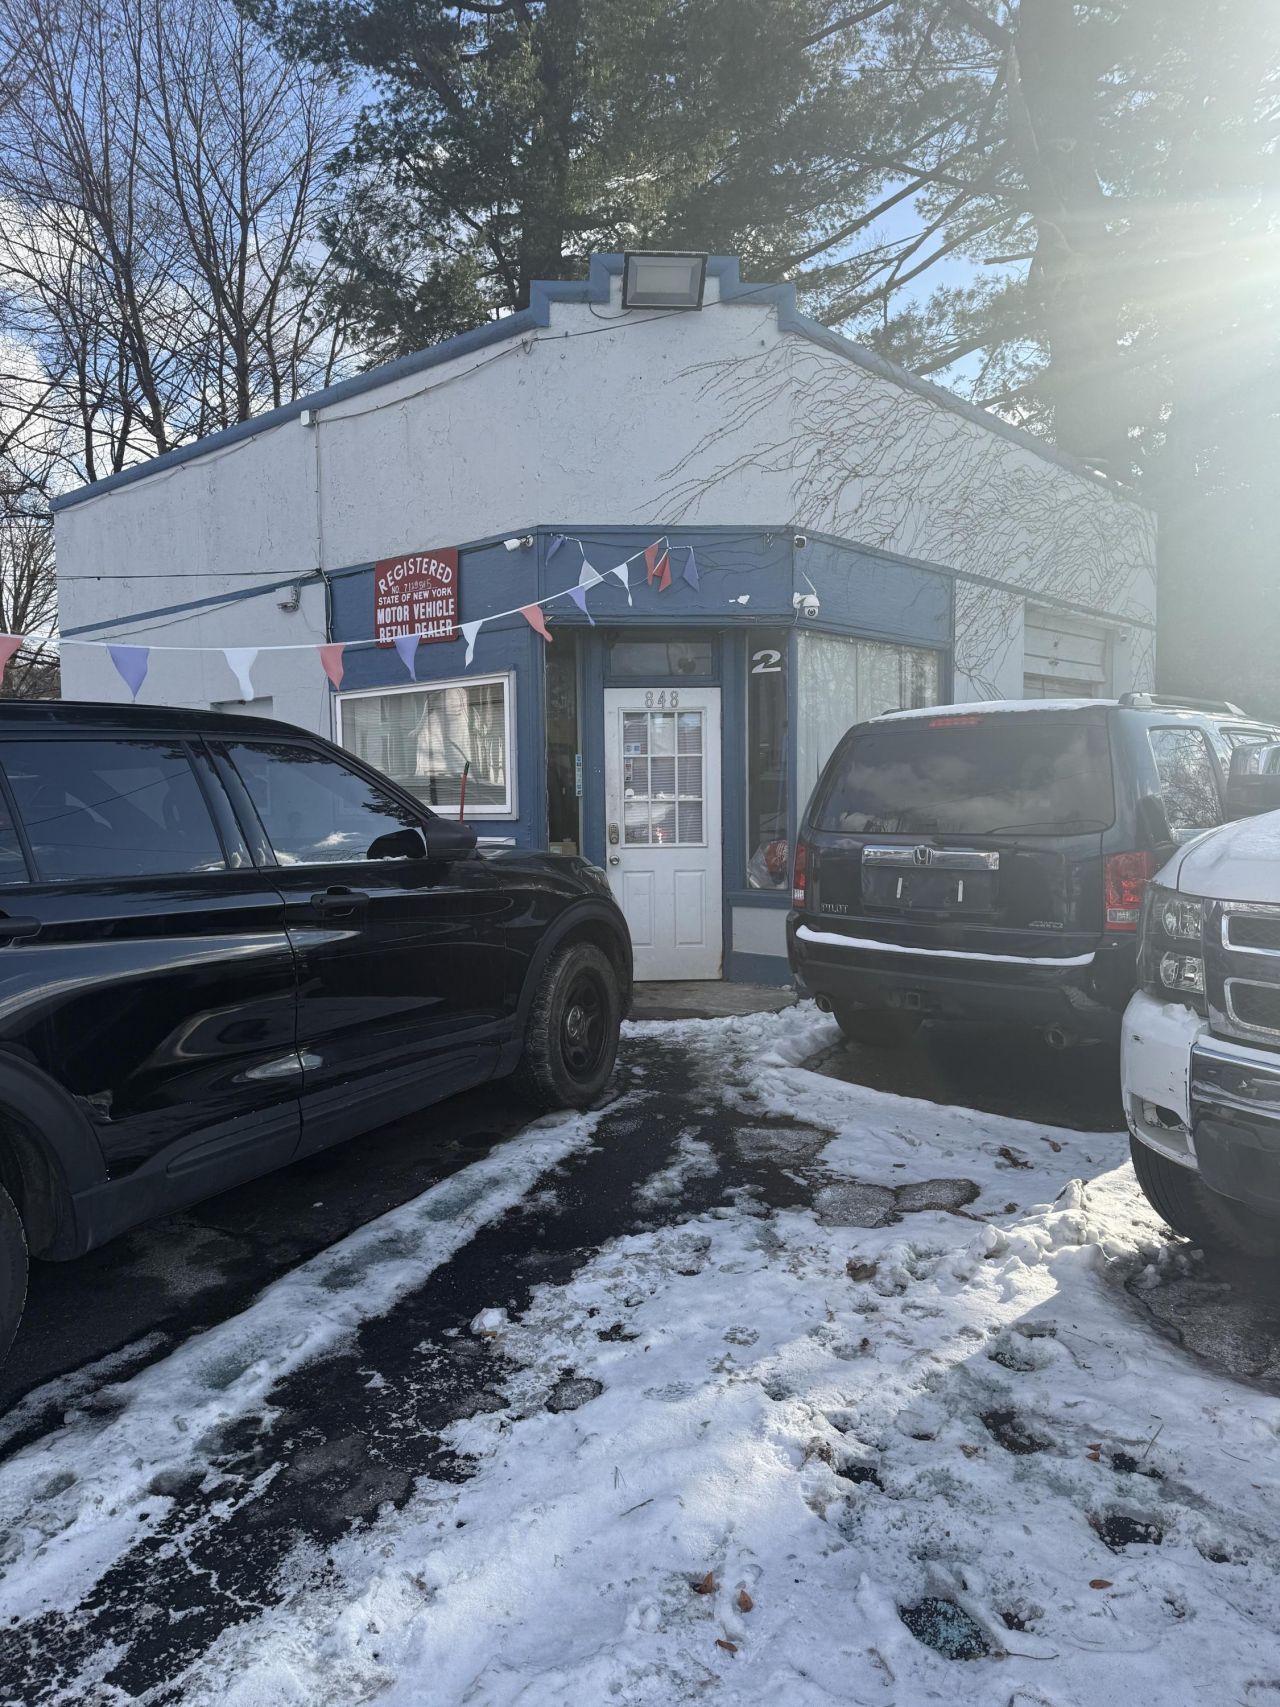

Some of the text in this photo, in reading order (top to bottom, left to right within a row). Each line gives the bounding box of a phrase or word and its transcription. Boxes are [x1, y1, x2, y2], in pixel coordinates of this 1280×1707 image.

[378, 557, 453, 594] REGISTERED
[378, 587, 453, 606] STATE OF NEW YORK
[377, 598, 455, 625] MOTOR VEHICLE
[414, 618, 453, 639] DEALER
[752, 649, 782, 674] 2
[645, 690, 679, 709] 848
